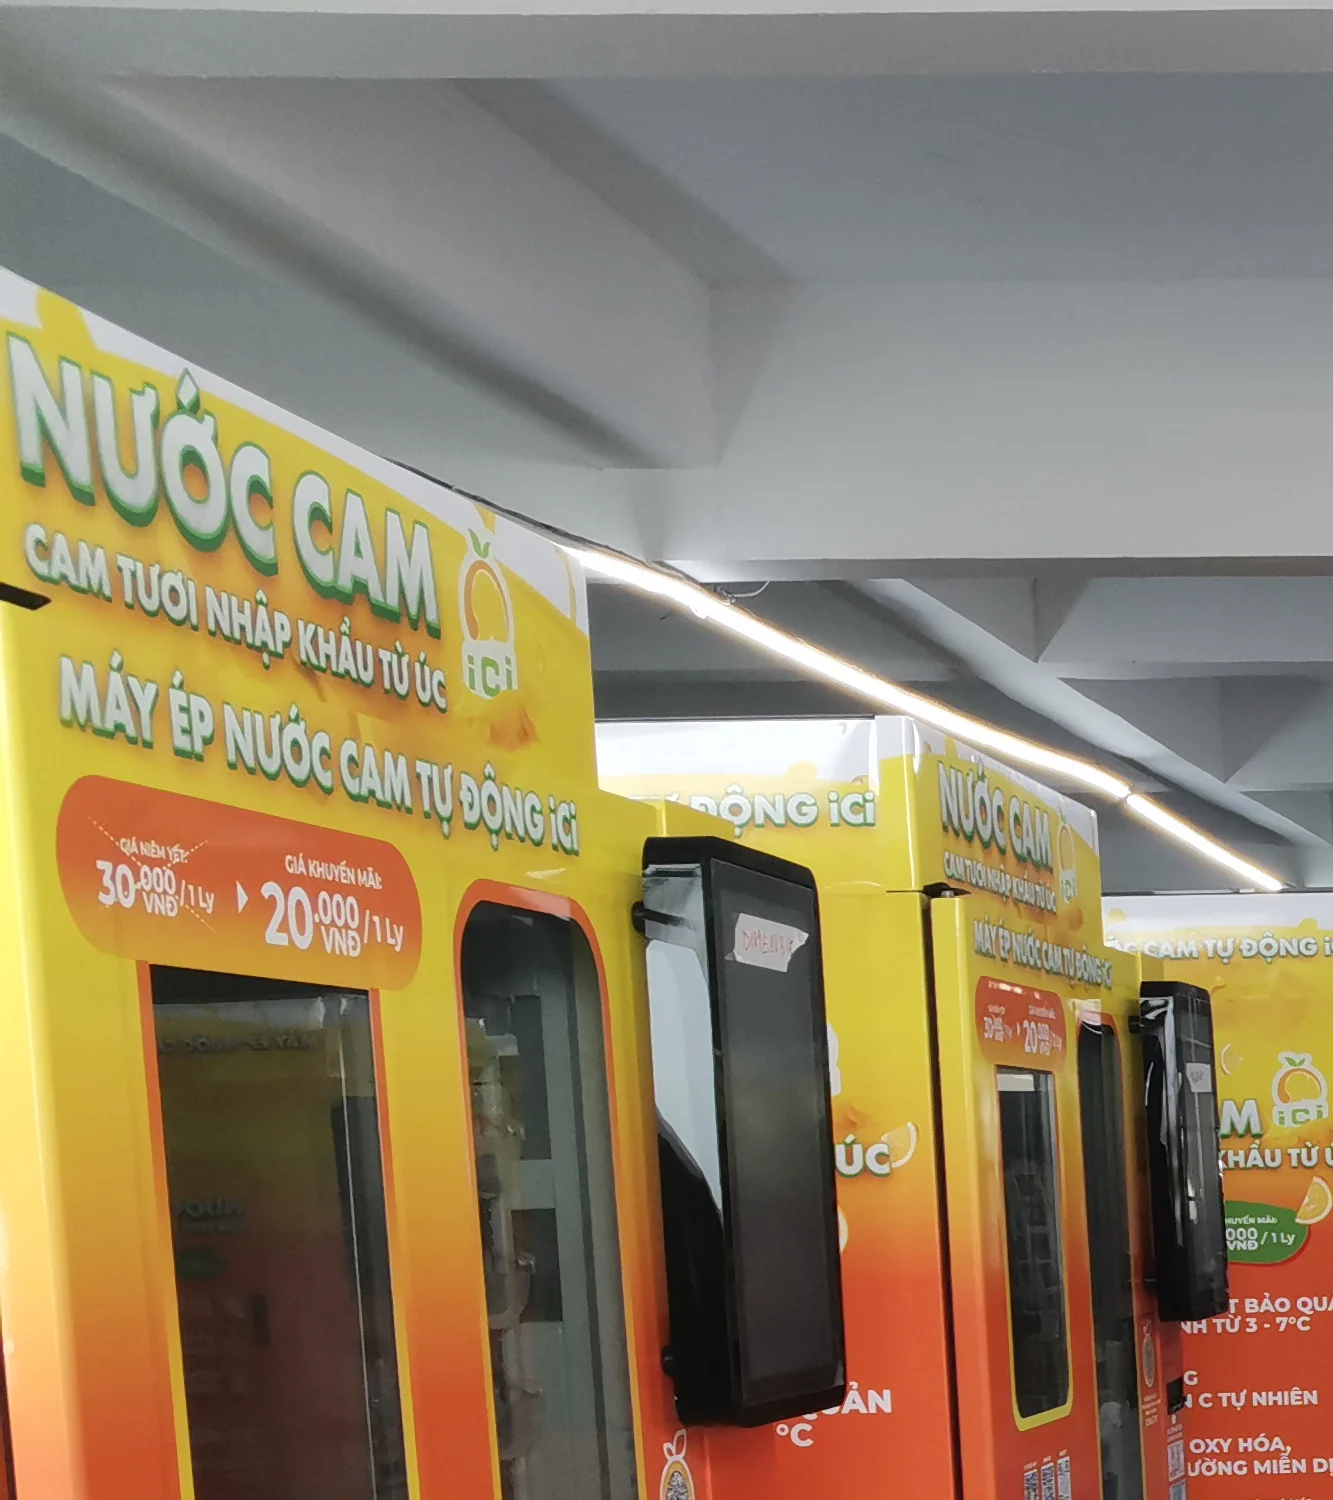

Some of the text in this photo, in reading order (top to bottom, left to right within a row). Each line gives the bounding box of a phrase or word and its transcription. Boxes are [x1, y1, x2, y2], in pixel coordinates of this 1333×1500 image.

[6, 331, 443, 640] NƯỚC CAM
[22, 521, 449, 713] CAM TƯƠI NHẬP KHẨU TỪ ÚC
[57, 650, 581, 858] MÁY ÉP NƯỚC CAM TỰ ĐỘNG iCi
[937, 761, 1054, 874] NƯỚC CAM
[120, 836, 137, 857] GIÁ
[285, 853, 356, 886] GIÁ KHUYẾN
[142, 890, 178, 918] VNĐ
[320, 924, 362, 958] VNĐ
[973, 915, 1042, 971] MÁY NƯỚC
[1204, 931, 1319, 965] TỰ ĐỘNG
[1287, 1141, 1320, 1170] TỪ
[1245, 1292, 1291, 1314] BẢO
[1213, 1315, 1258, 1334] TỪ 3
[1218, 1387, 1319, 1411] TỰ NHIÊN
[1189, 1438, 1232, 1454] OXY
[1253, 1453, 1307, 1475] MIỄN
